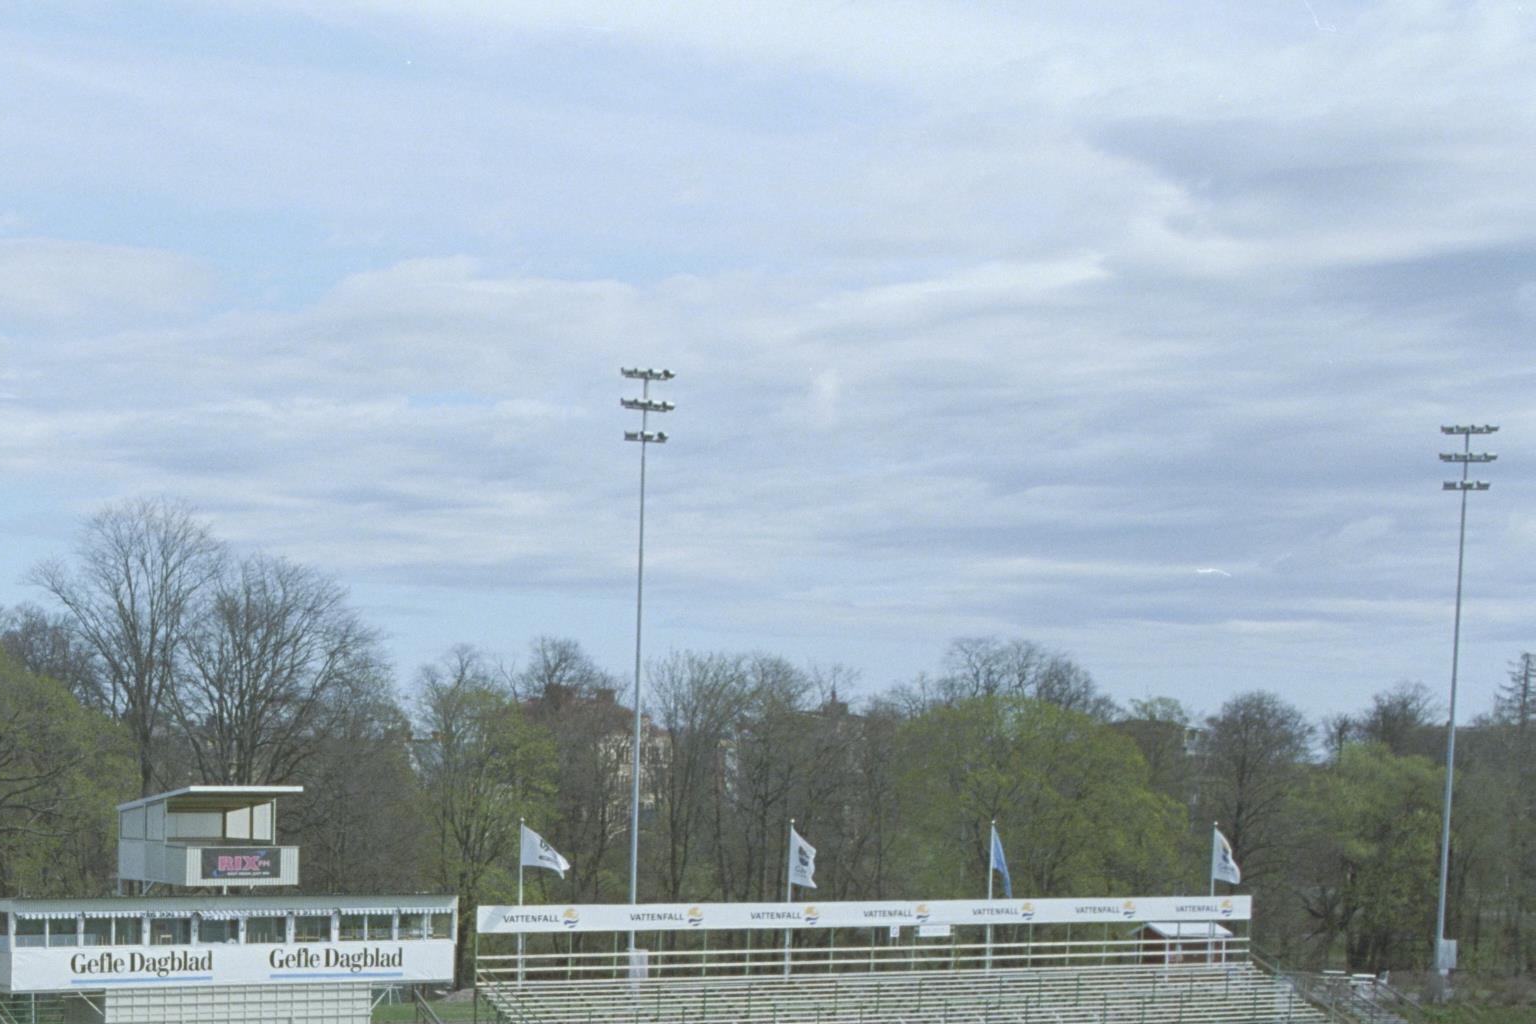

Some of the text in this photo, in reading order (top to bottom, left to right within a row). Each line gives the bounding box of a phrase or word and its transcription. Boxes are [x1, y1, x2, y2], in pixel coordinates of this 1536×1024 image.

[218, 855, 260, 871] RIX
[972, 907, 1018, 916] VATTENFALL
[1075, 906, 1120, 914] VATTENFALL
[1175, 904, 1218, 913] VATTENFALL
[503, 914, 559, 923] VATTENFALL
[630, 913, 684, 921] VATTENFALL
[750, 912, 801, 920] VATTENFALL
[863, 910, 912, 918] VATTENFALL
[70, 949, 213, 978] Gefle Dagblad
[269, 946, 403, 974] Gefle Dagblad
